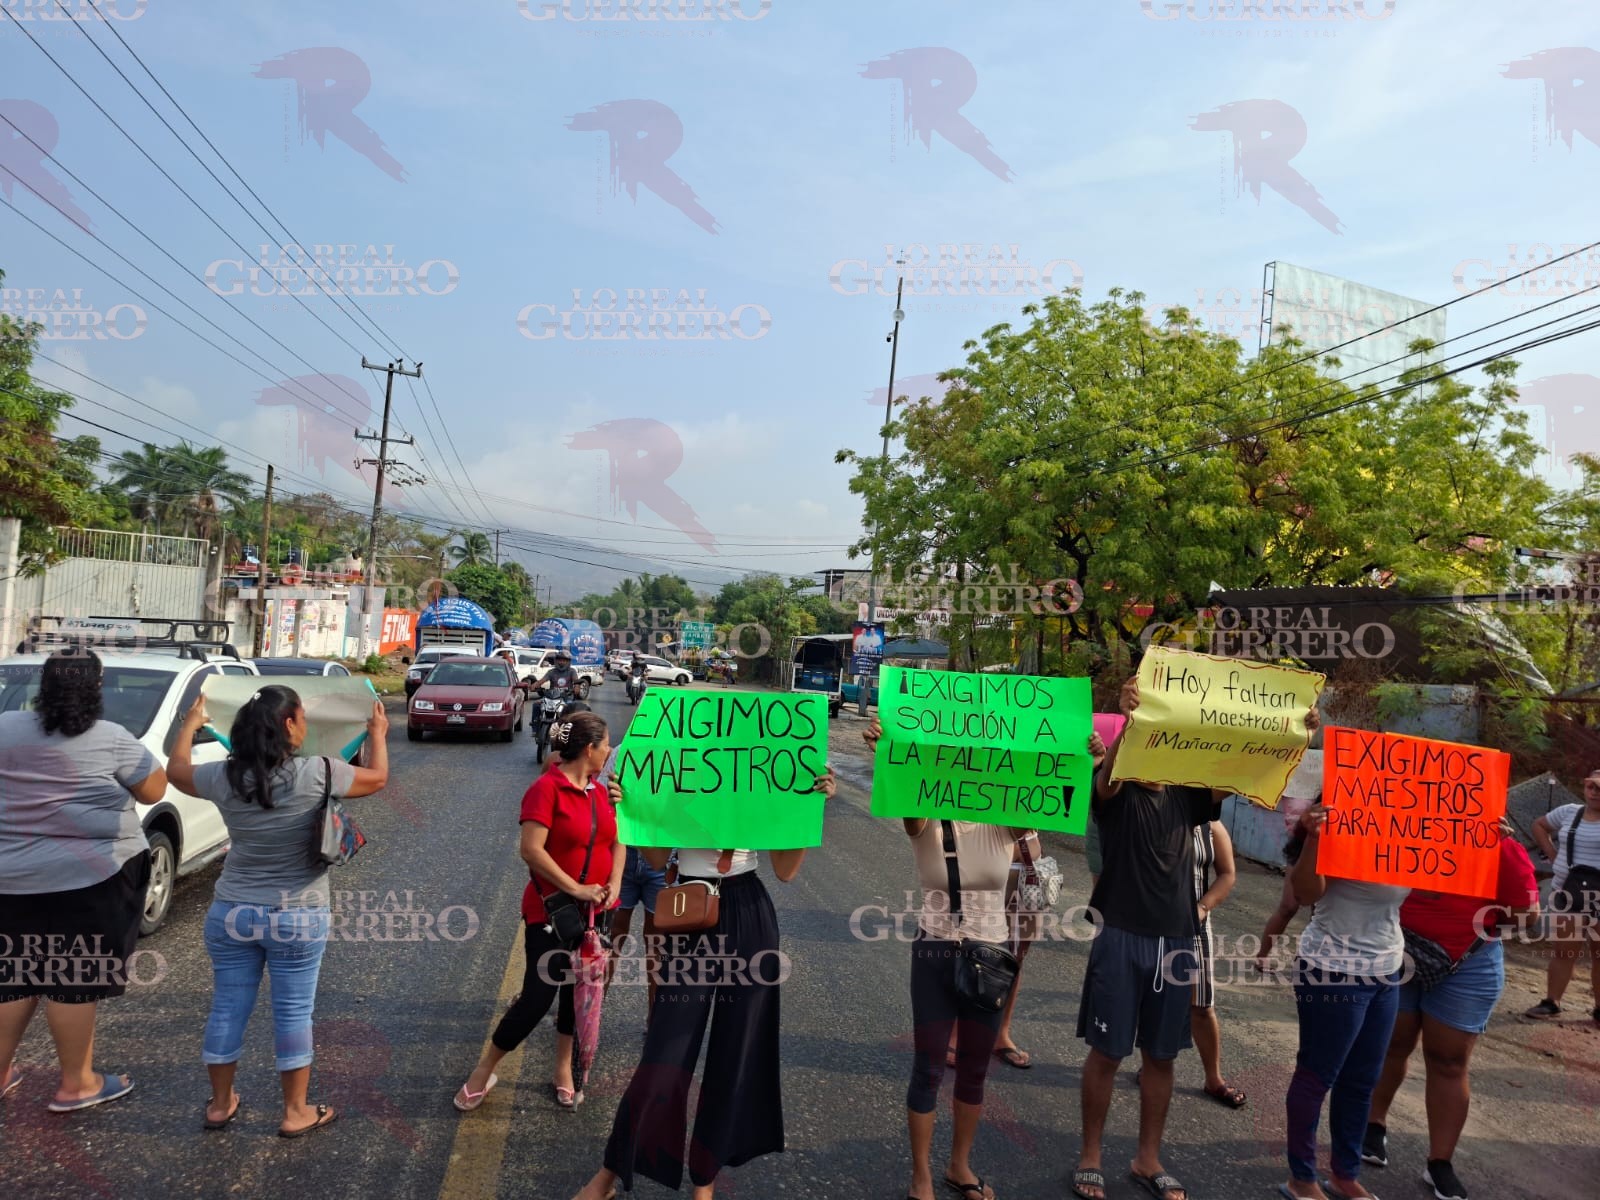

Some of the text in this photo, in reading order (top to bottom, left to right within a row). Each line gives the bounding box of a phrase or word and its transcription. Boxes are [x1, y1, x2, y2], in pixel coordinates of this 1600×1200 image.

[382, 614, 411, 643] STIHL
[899, 670, 1054, 709] ¡EXIGIMOS
[1223, 670, 1296, 709] faltan
[629, 692, 816, 740] EXIGIMOS
[896, 706, 1057, 743] SOLUCIÓN A
[617, 745, 818, 795] MAESTROS
[888, 740, 1075, 780] LA FALTA DE
[1335, 729, 1484, 787] EXIGIMOS
[917, 778, 1076, 818] MAESTROS!
[1333, 775, 1484, 817] MAESTROS
[1325, 807, 1499, 848] PARA NUESTROS
[1375, 842, 1457, 877] HIJOS
